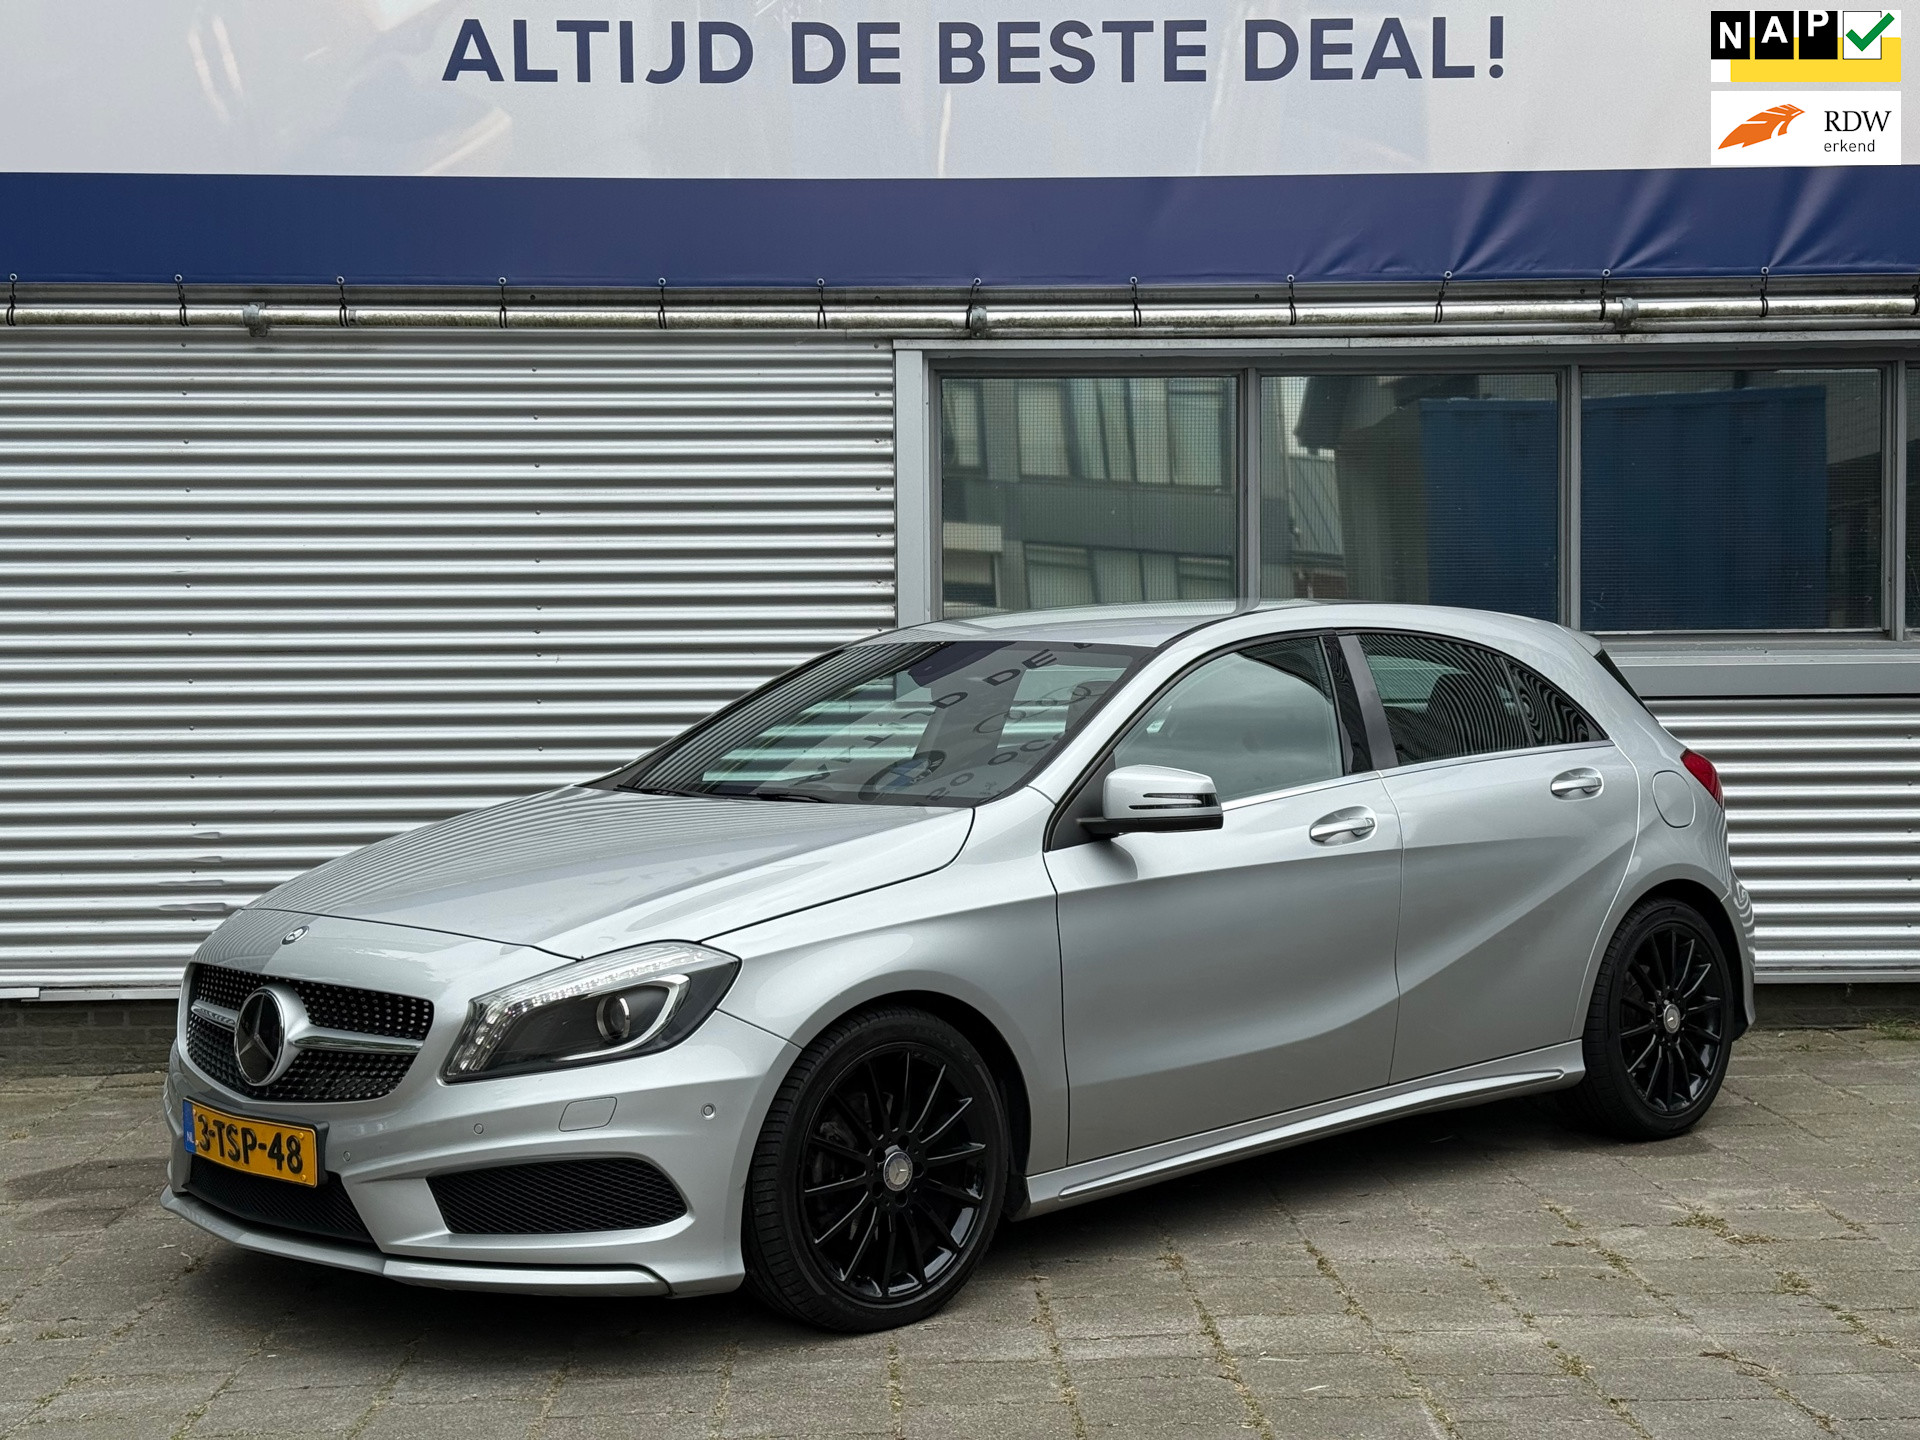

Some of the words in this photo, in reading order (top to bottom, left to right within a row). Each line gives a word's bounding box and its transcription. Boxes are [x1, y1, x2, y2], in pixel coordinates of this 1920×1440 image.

[443, 19, 753, 85] ALTIJD
[792, 22, 899, 85] DE
[940, 20, 1207, 84] BESTE
[1246, 18, 1503, 81] DEAL!
[197, 1113, 304, 1174] 3-TSP-48
